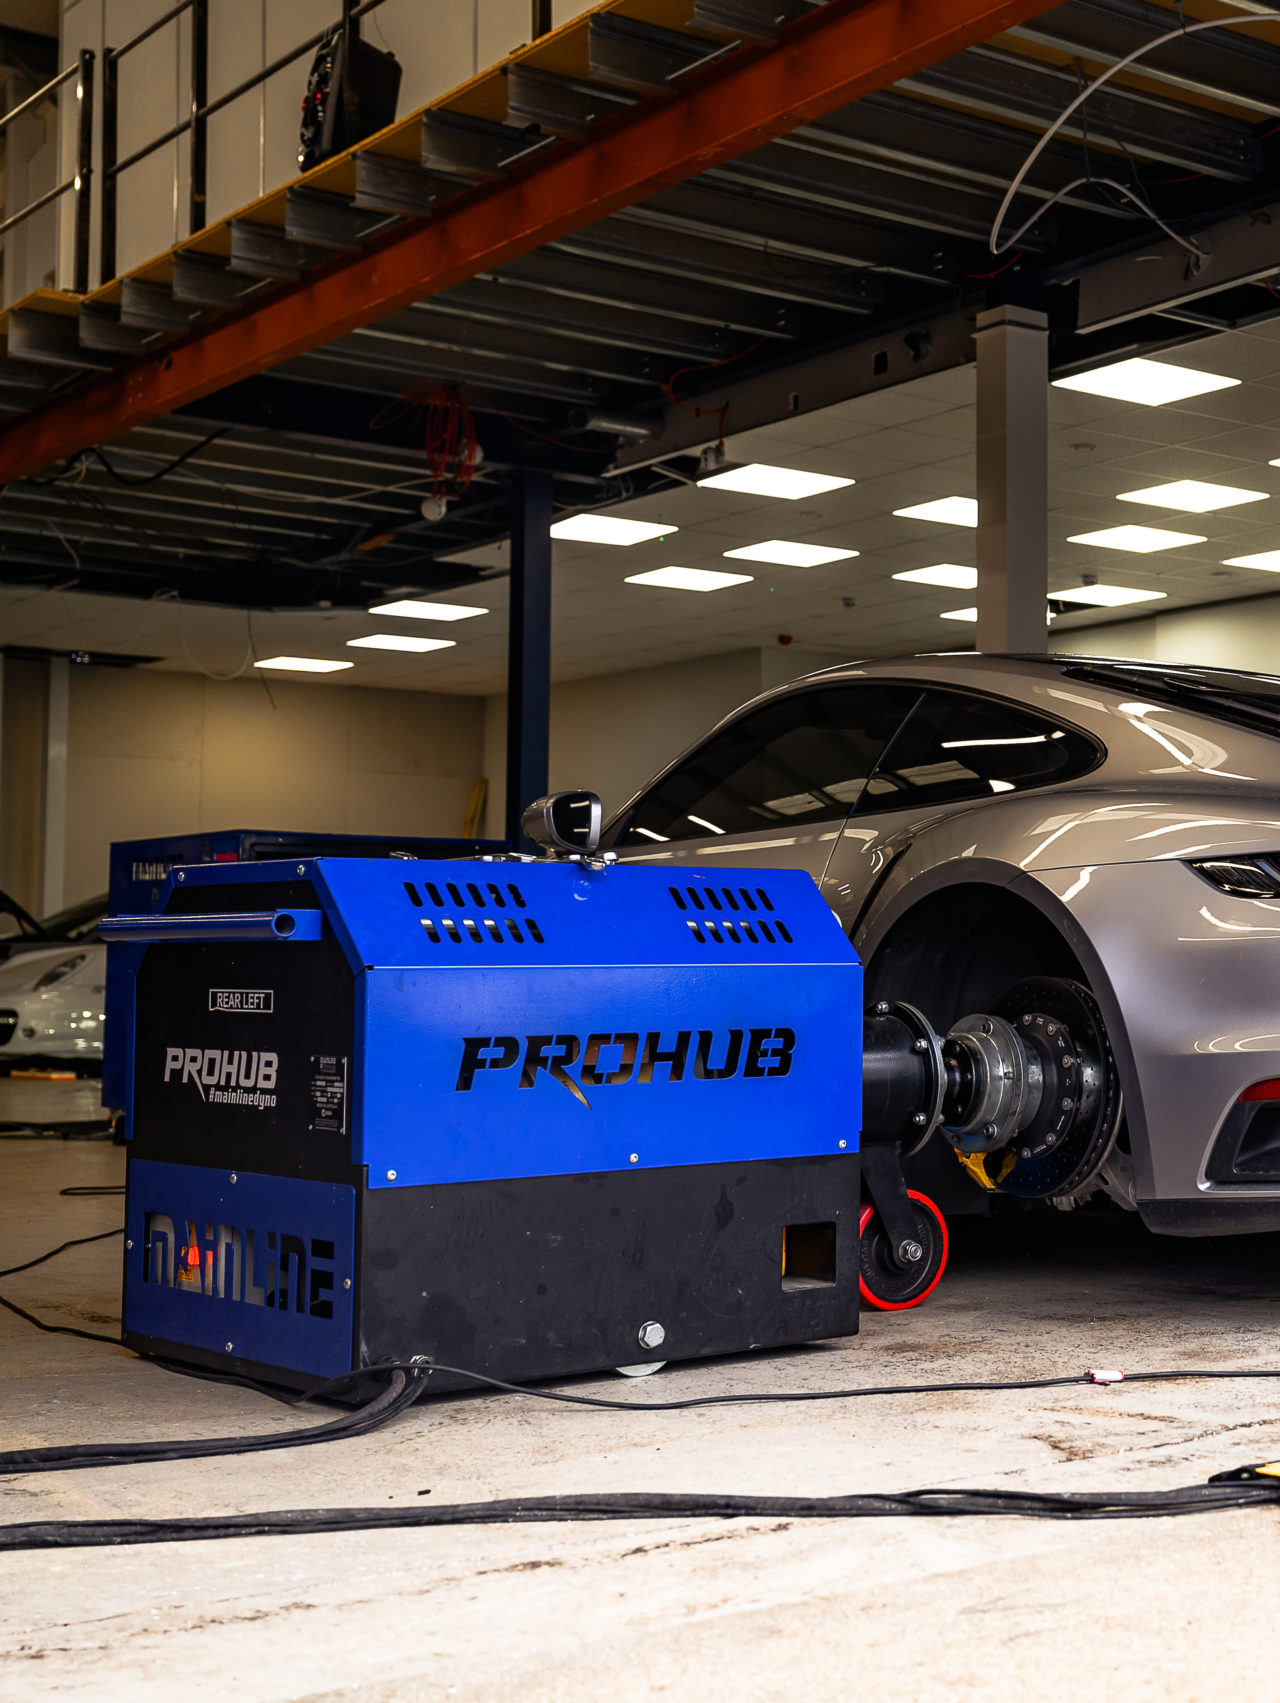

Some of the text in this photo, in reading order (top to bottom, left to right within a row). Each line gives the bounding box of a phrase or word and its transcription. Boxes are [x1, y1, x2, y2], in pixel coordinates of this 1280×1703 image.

[217, 993, 265, 1009] REAR LEFT
[164, 1047, 278, 1102] PROHUB
[455, 1028, 796, 1111] PROHUB
[209, 1087, 277, 1110] #mainlinedyno
